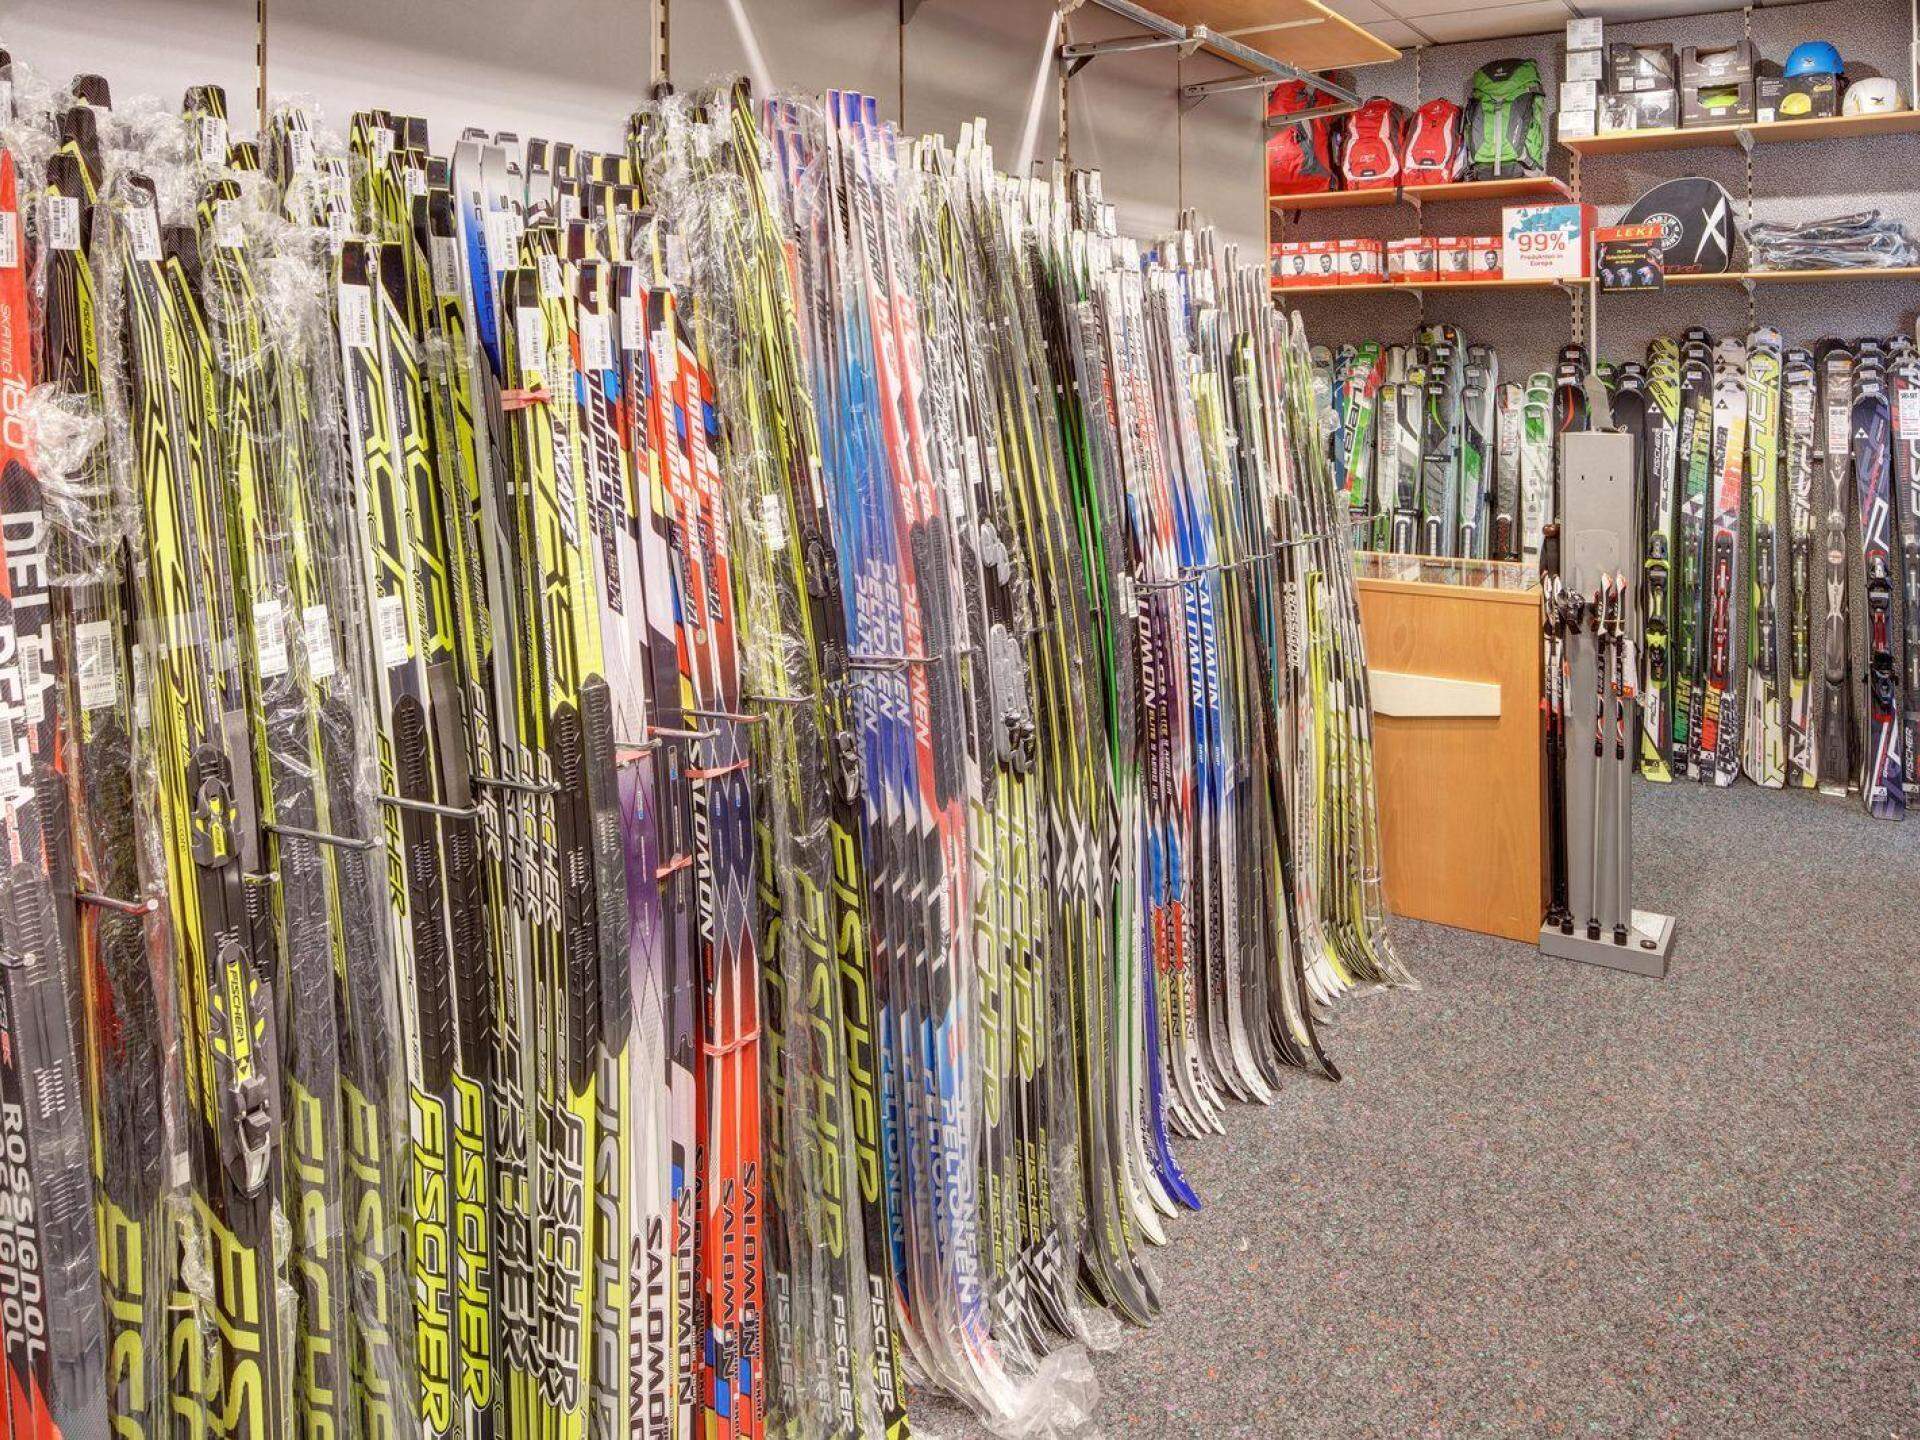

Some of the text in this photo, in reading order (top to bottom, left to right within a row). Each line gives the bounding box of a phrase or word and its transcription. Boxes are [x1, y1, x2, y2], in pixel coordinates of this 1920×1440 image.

[472, 191, 482, 221] SC
[1517, 232, 1565, 252] 99%
[1616, 228, 1655, 237] LEKI
[1, 304, 29, 450] SKATING 180
[84, 301, 93, 347] FISCHER
[165, 320, 175, 368] FISCHER
[204, 366, 212, 409] FISCHER
[1905, 727, 1914, 781] FISCHER
[230, 971, 244, 1043] FISCHER
[799, 873, 842, 1257] FISCHER
[831, 821, 879, 1202] FISCHER
[882, 1048, 904, 1241] PELTONEN
[942, 1098, 972, 1303] PELTONEN
[3, 1103, 45, 1353] ROSSIGNOL
[411, 1083, 450, 1433] FISCHER
[453, 1070, 491, 1408] FISCHER
[556, 1099, 586, 1413] FISCHER
[677, 1187, 692, 1405] SALOMON
[723, 1179, 737, 1378] SALOMON
[743, 1162, 757, 1358] SALOMON
[992, 1173, 1004, 1278] FISCHER
[777, 1273, 795, 1410] FISCHER
[832, 1294, 855, 1433] FISCHER
[870, 1274, 894, 1412] FISCHER
